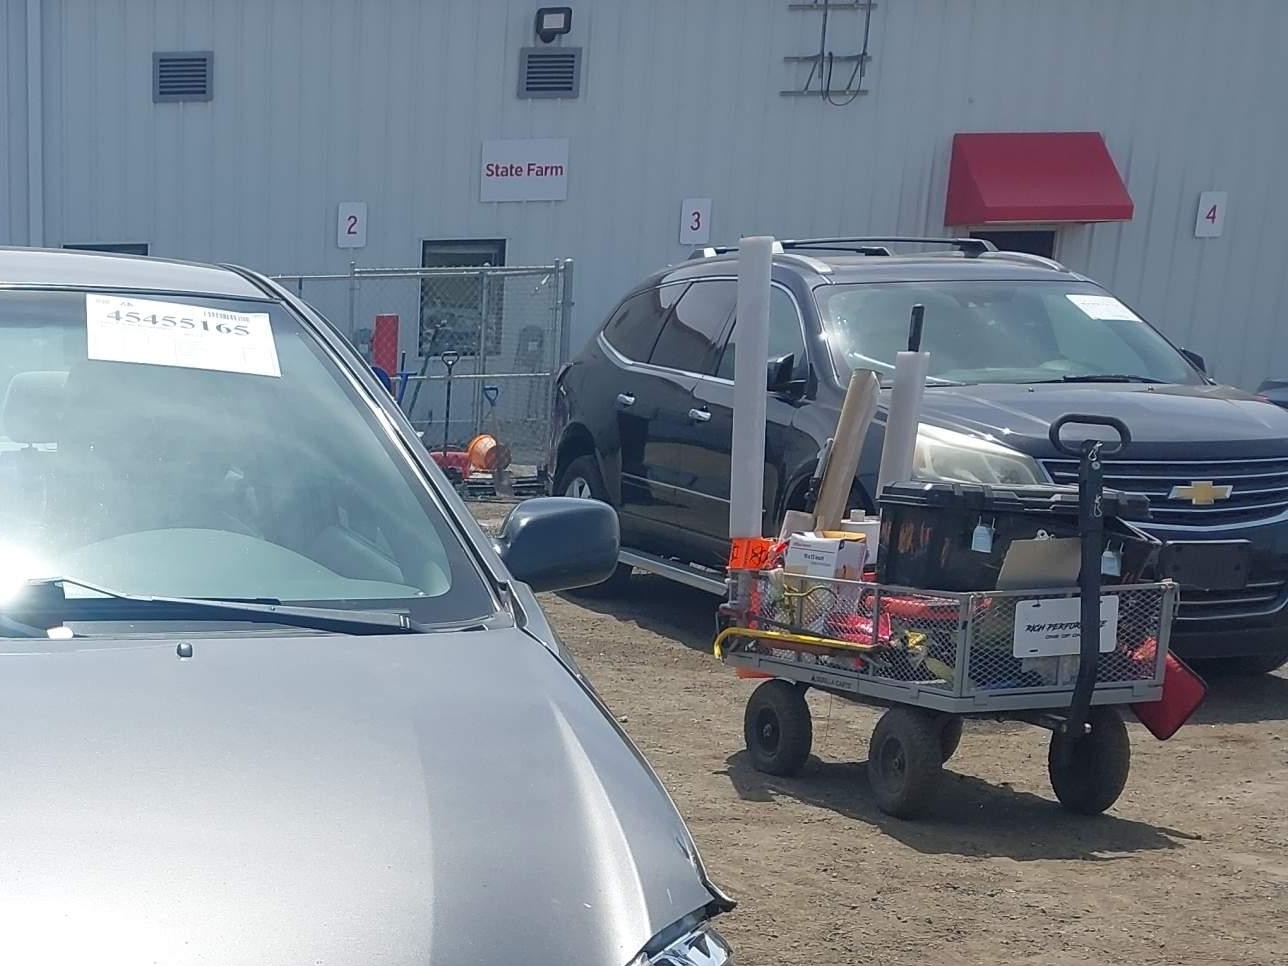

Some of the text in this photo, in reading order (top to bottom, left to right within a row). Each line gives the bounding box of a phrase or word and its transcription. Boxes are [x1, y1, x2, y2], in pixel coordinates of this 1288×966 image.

[485, 162, 564, 177] State Farm
[690, 211, 701, 231] 3
[1205, 204, 1217, 225] 4
[347, 215, 358, 235] 2
[106, 309, 251, 337] 45455165
